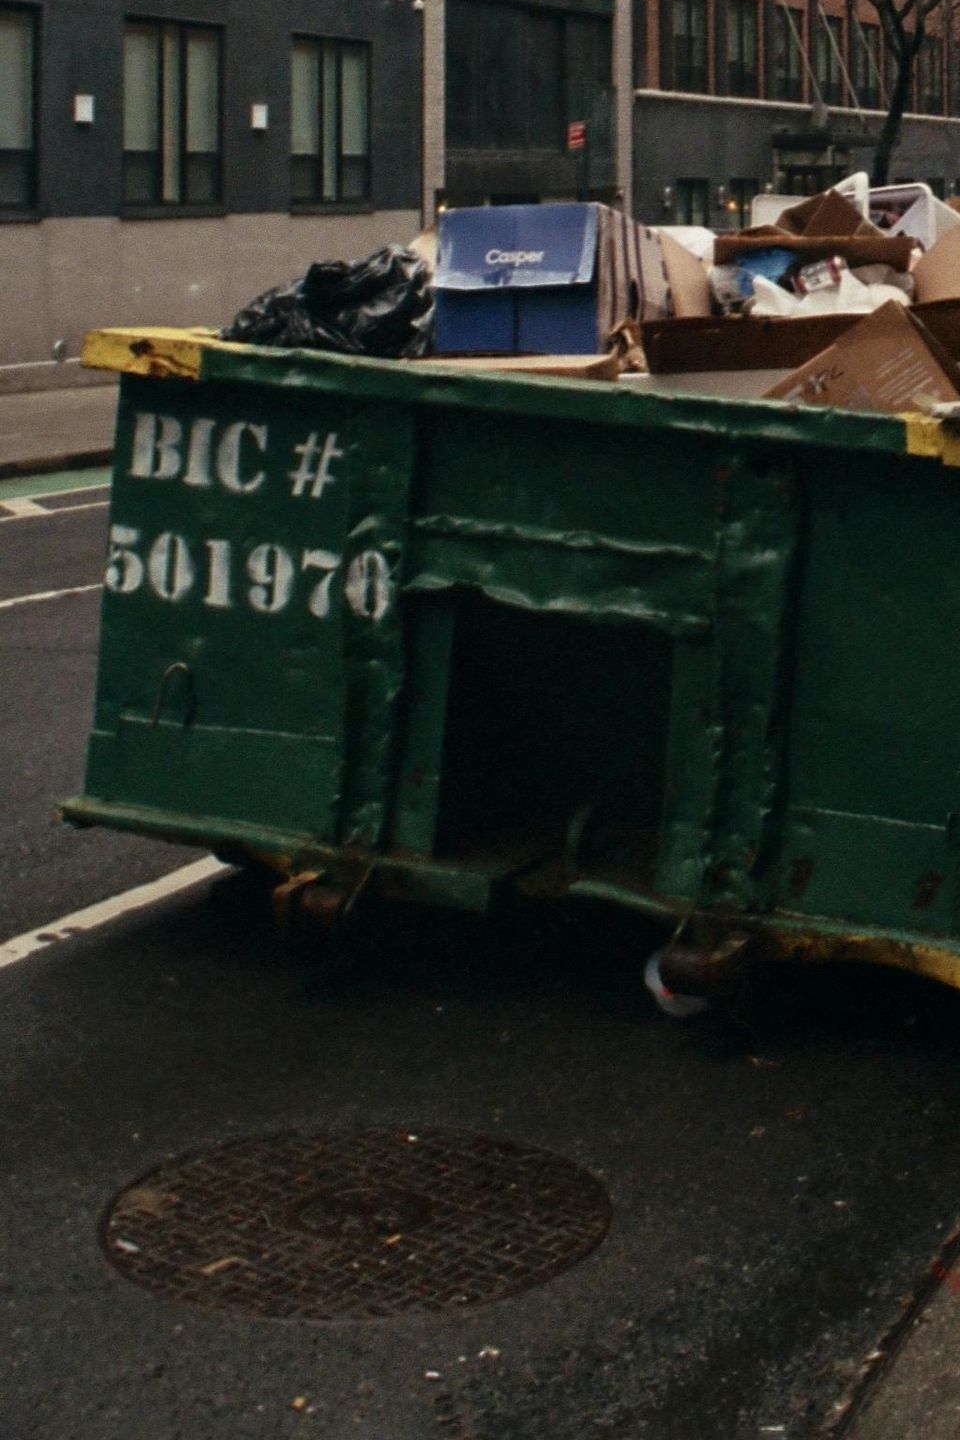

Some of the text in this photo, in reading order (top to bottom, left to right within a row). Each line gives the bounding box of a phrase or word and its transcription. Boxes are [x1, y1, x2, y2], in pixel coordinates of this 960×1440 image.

[485, 249, 544, 267] Casper
[129, 412, 344, 498] BIC #
[105, 523, 392, 622] 501970
